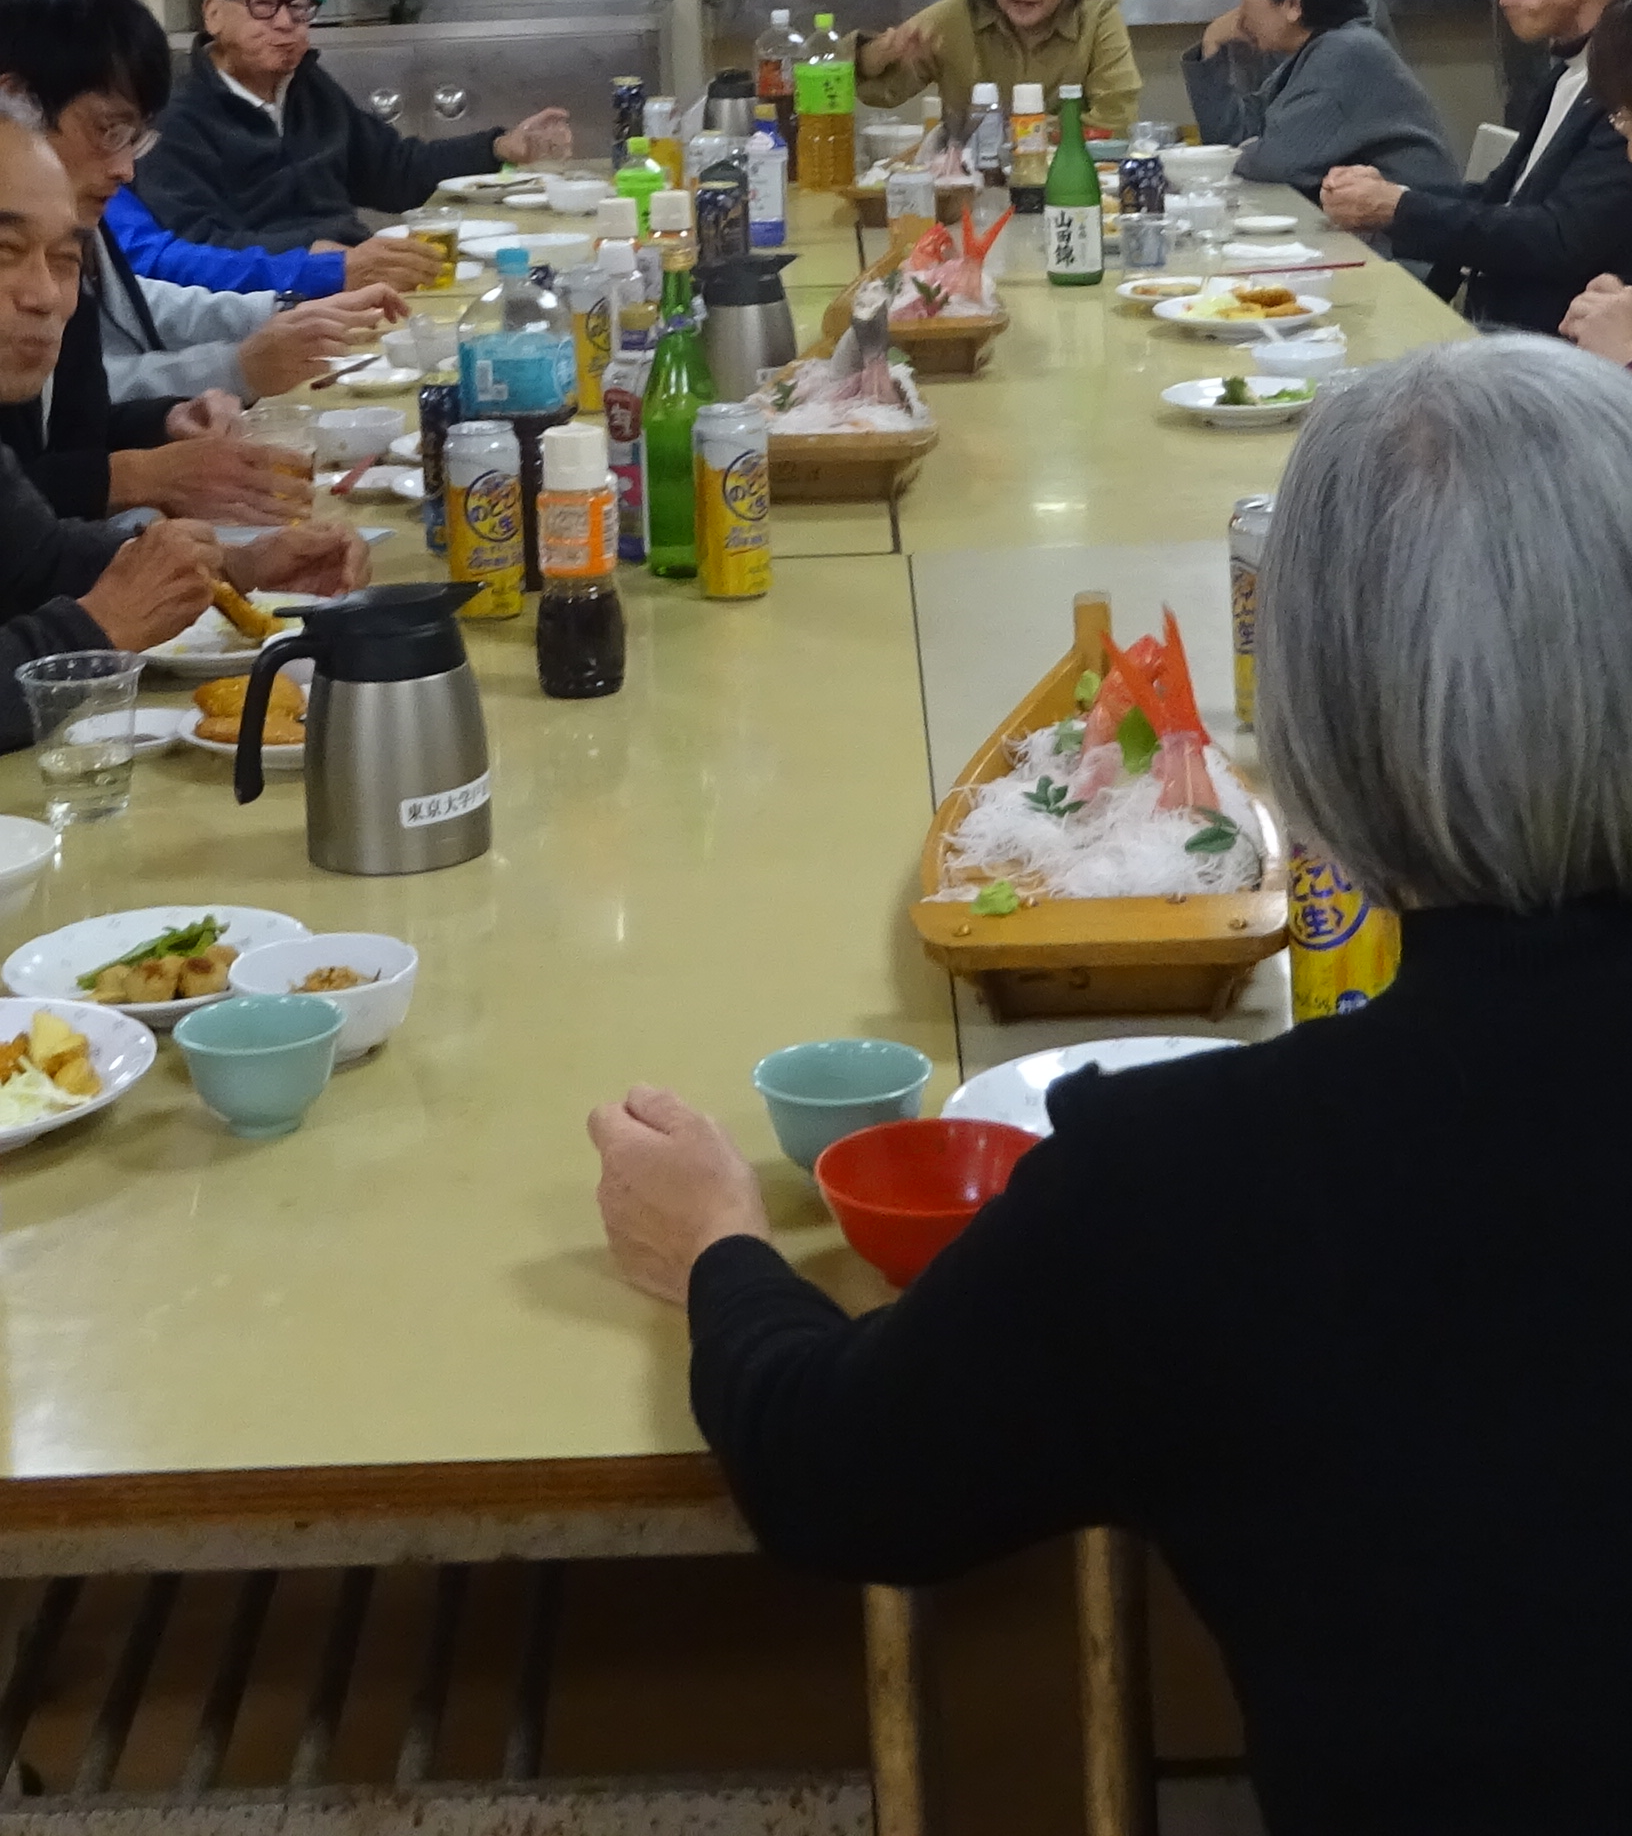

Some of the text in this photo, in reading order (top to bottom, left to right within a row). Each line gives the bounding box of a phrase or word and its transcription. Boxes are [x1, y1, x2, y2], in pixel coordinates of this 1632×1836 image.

[1054, 210, 1076, 266] 山田錦
[408, 776, 490, 824] 東京大学戸
